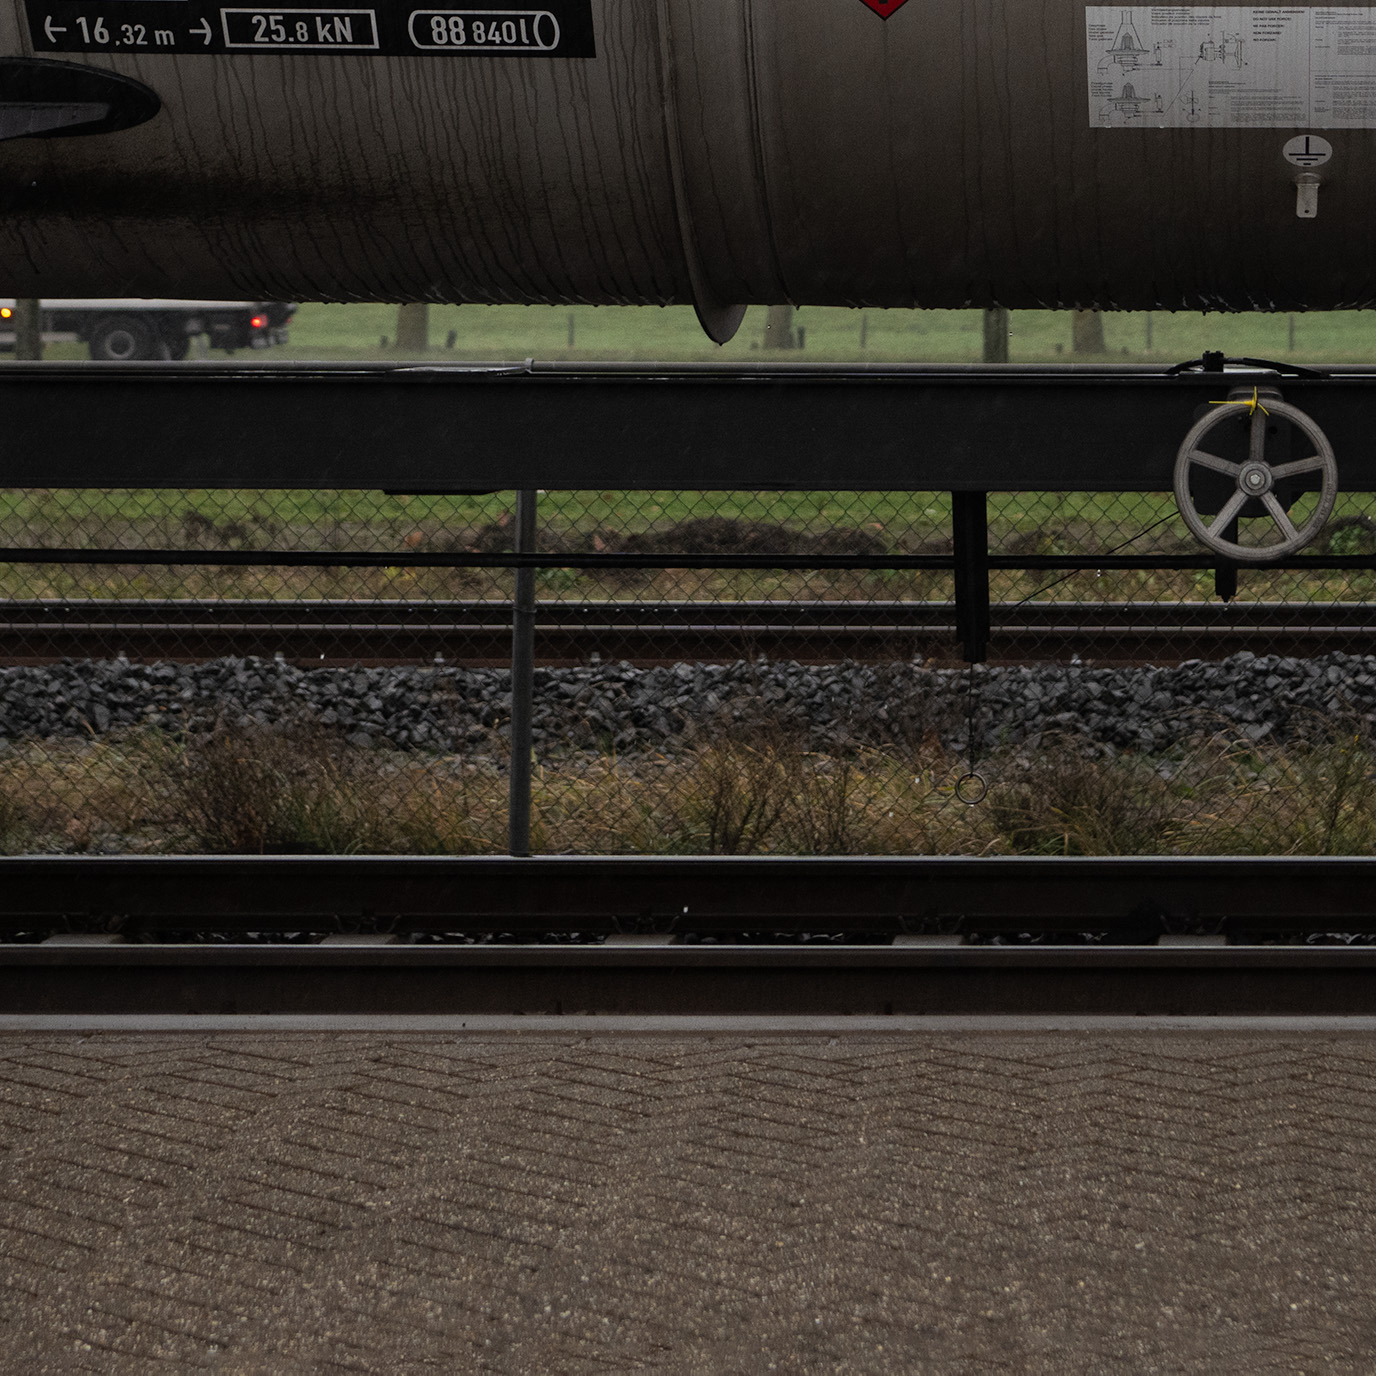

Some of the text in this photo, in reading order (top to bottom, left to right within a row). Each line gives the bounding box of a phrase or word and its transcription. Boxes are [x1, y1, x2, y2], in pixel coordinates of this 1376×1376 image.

[154, 29, 176, 46] m
[251, 14, 354, 43] 25.8 kN
